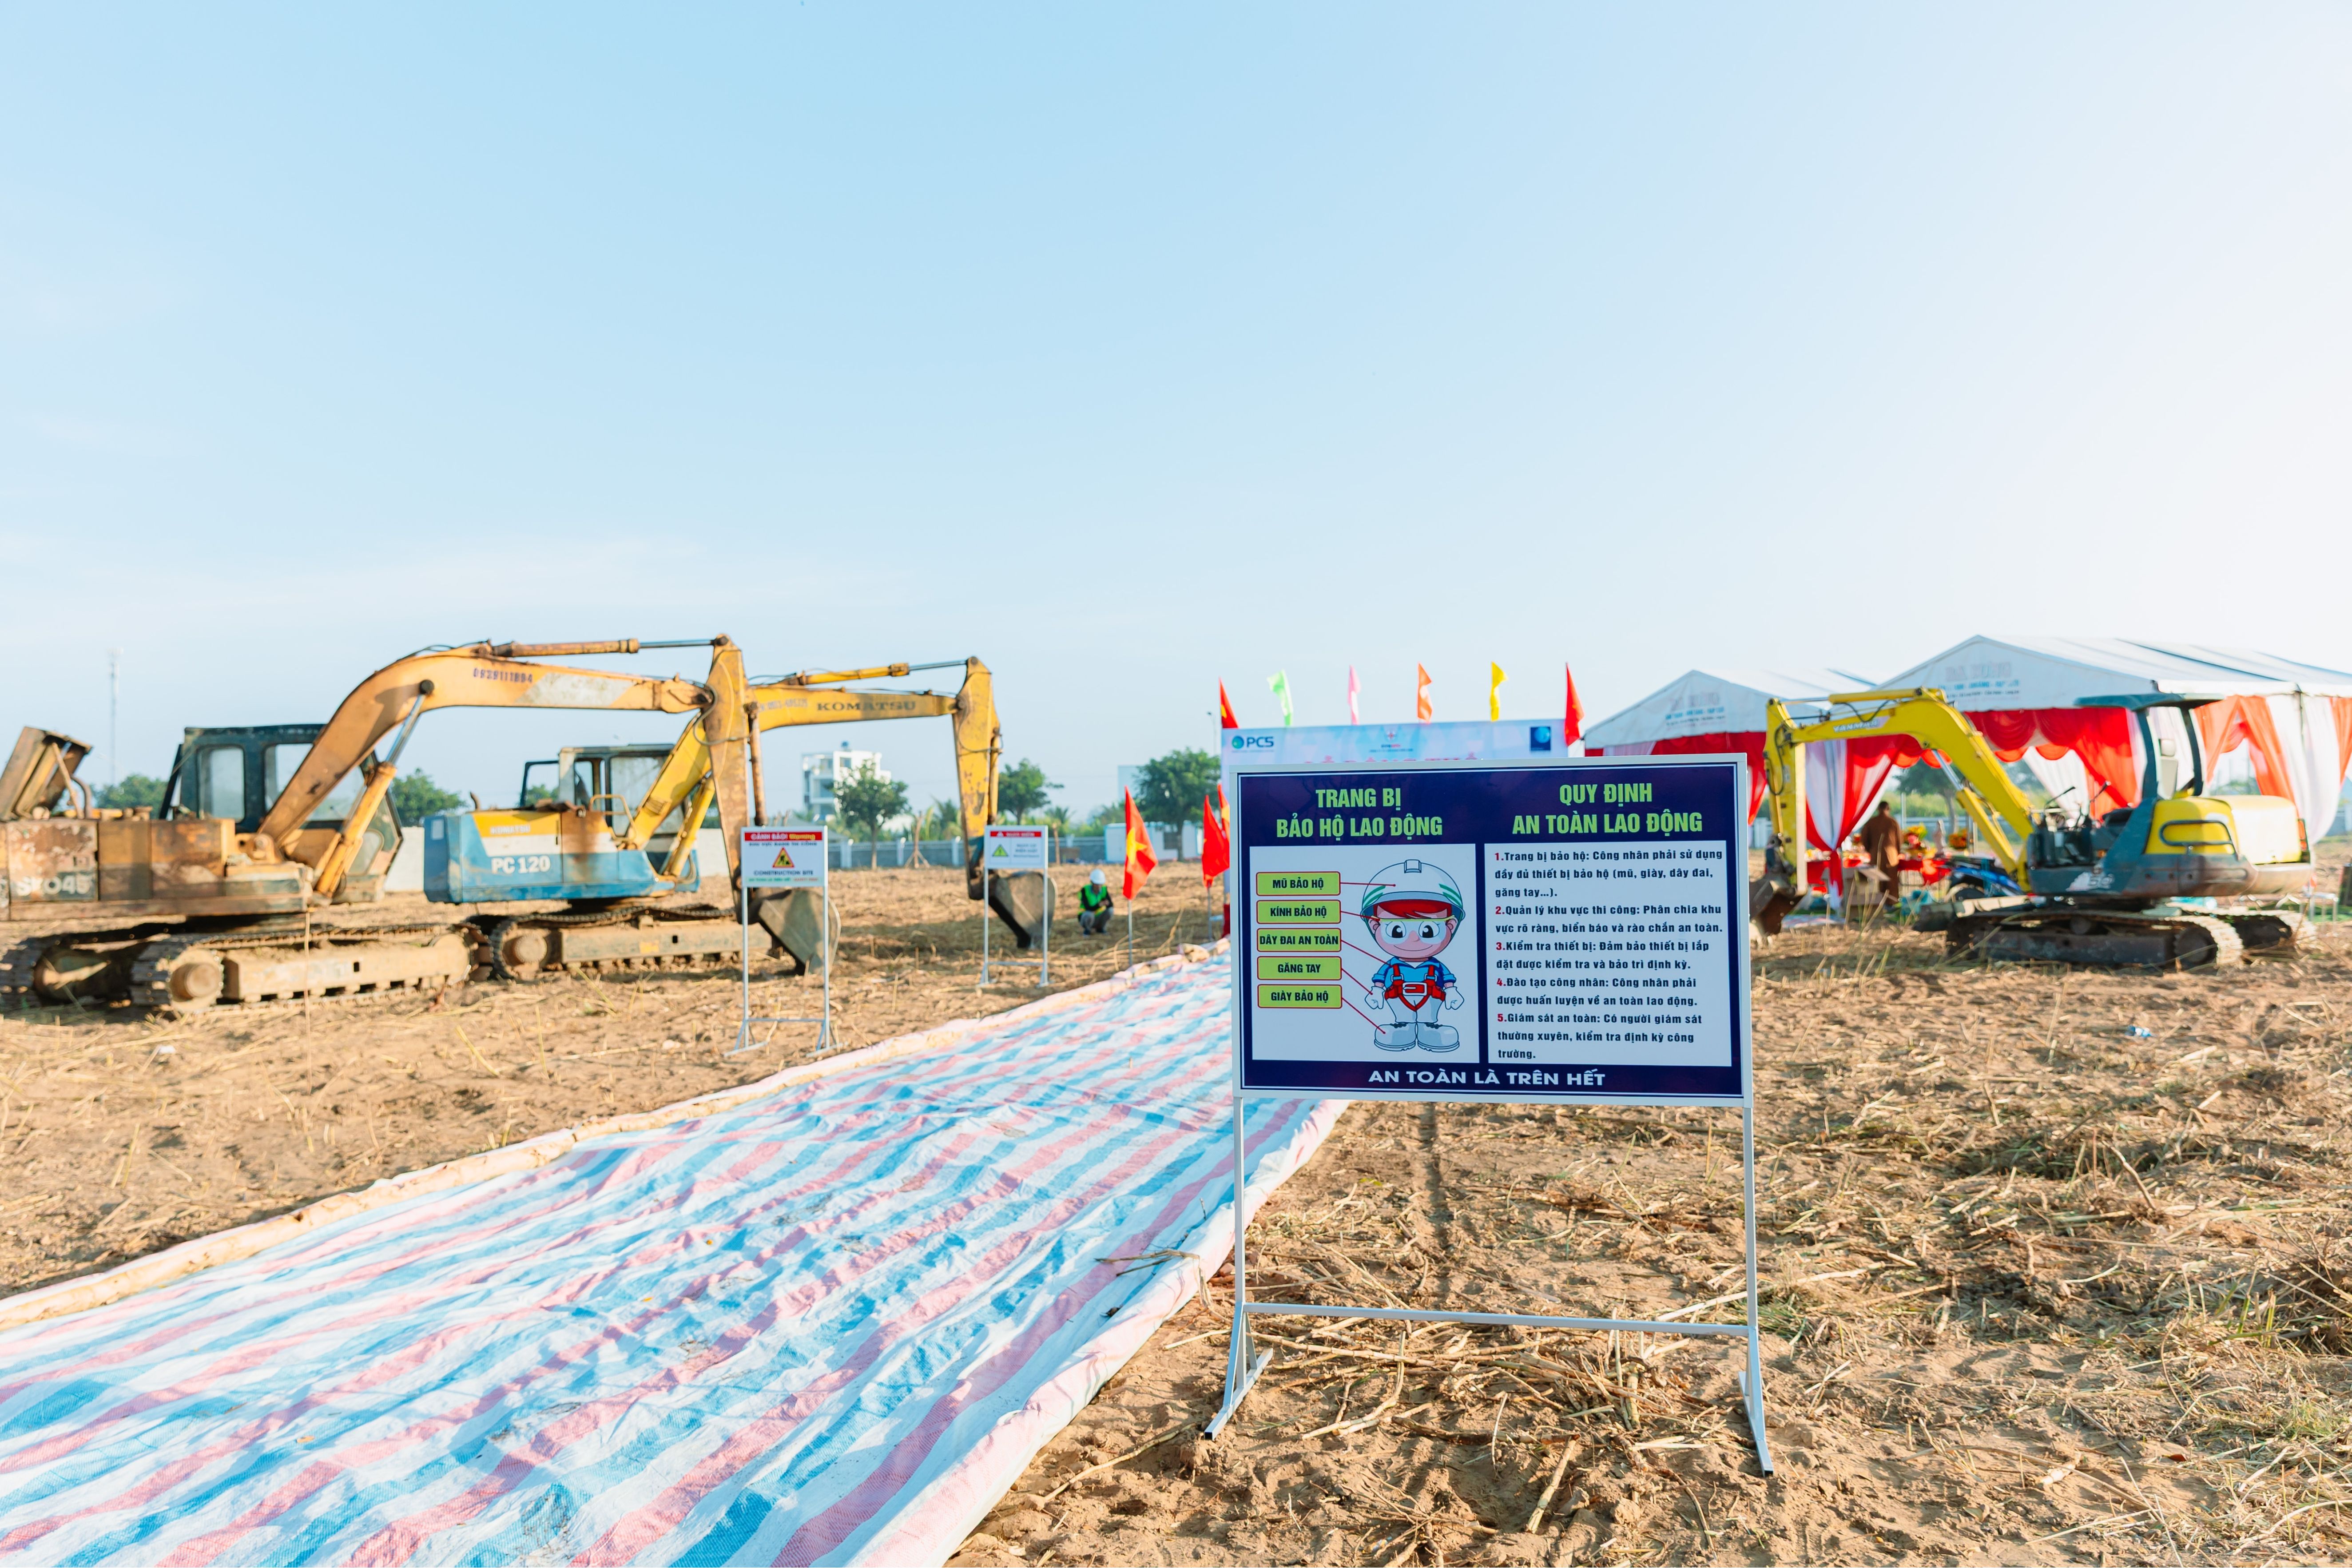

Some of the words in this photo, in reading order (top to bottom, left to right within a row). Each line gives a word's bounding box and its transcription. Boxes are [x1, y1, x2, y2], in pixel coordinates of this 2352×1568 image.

[817, 701, 916, 711] KOMATSU
[1247, 736, 1274, 747] PCS
[1315, 789, 1376, 807] TRANG
[1383, 789, 1400, 810] BỊ
[1560, 784, 1597, 805] QUY
[1603, 783, 1652, 806] ĐỊNH
[1276, 813, 1313, 838] BẢO
[1320, 814, 1344, 840] HỘ
[1350, 818, 1384, 837] LAO
[1390, 814, 1442, 840] ĐỘNG
[1512, 816, 1539, 834] AN
[1545, 810, 1597, 834] TOÀN
[1604, 814, 1640, 833] LAO
[1645, 809, 1702, 836] ĐỘNG
[491, 825, 531, 834] KOMATSU
[1537, 852, 1547, 862] bị
[1550, 850, 1569, 861] bảo
[1573, 851, 1589, 862] hộ:
[1593, 851, 1619, 861] Công
[1623, 850, 1649, 860] nhân
[1653, 849, 1676, 860] phải
[1680, 849, 1692, 859] sử
[1696, 850, 1722, 861] dụng
[492, 857, 515, 874] PC
[517, 855, 551, 874] 120
[1495, 869, 1513, 880] đầy
[1517, 869, 1529, 878] đủ
[1532, 868, 1557, 878] thiết
[1560, 869, 1570, 880] bị
[1573, 868, 1593, 878] bảo
[1596, 869, 1609, 880] hộ
[1613, 869, 1637, 879] (mũ,
[1641, 868, 1666, 879] giày,
[1669, 868, 1689, 878] dây
[1692, 868, 1713, 878] đai,
[1272, 878, 1287, 889] MŨ
[1290, 877, 1308, 888] BẢO
[1311, 877, 1324, 890] HỘ
[1495, 888, 1521, 898] găng
[1524, 888, 1557, 897] tay...).
[1270, 906, 1291, 917] KÍNH
[1294, 905, 1312, 917] BẢO
[1315, 906, 1327, 918] HỘ
[1535, 905, 1544, 916] lý
[1548, 906, 1567, 914] khu
[1570, 906, 1589, 916] vực
[1592, 905, 1606, 914] thi
[1610, 905, 1640, 915] công:
[1643, 905, 1670, 914] Phân
[1674, 905, 1697, 914] chia
[1701, 905, 1721, 913] khu
[1495, 925, 1514, 934] vực
[1518, 924, 1528, 933] rõ
[1531, 923, 1558, 933] ràng,
[1562, 922, 1585, 933] biển
[1589, 923, 1608, 933] báo
[1611, 923, 1624, 933] và
[1627, 923, 1645, 933] rào
[1649, 921, 1675, 933] chắn
[1694, 923, 1722, 932] toàn.
[1259, 934, 1277, 945] DÂY
[1280, 936, 1295, 945] ĐAI
[1298, 936, 1311, 945] AN
[1314, 934, 1339, 945] TOÀN
[1536, 942, 1551, 951] tra
[1554, 940, 1579, 951] thiết
[1582, 942, 1596, 953] bị:
[1599, 941, 1623, 951] Đảm
[1626, 941, 1646, 951] bảo
[1649, 940, 1675, 951] thiết
[1678, 941, 1688, 953] bị
[1692, 940, 1709, 952] lắp
[1278, 962, 1303, 973] GĂNG
[1306, 964, 1321, 973] TAY
[1496, 960, 1513, 970] đặt
[1516, 960, 1542, 970] được
[1545, 958, 1572, 969] kiểm
[1575, 960, 1590, 969] tra
[1593, 960, 1605, 969] và
[1609, 959, 1628, 969] bảo
[1631, 960, 1644, 969] trì
[1648, 960, 1671, 971] định
[1675, 960, 1691, 970] kỳ.
[1530, 978, 1546, 988] tạo
[1550, 977, 1576, 988] công
[1579, 978, 1609, 987] nhân:
[1612, 978, 1639, 988] Công
[1642, 978, 1669, 987] nhân
[1673, 977, 1696, 988] phải
[1271, 990, 1292, 1001] GIÀY
[1295, 989, 1313, 1001] BẢO
[1316, 990, 1328, 1003] HỘ
[1497, 996, 1522, 1006] được
[1526, 994, 1552, 1004] huấn
[1555, 996, 1584, 1007] luyện
[1587, 995, 1600, 1005] về
[1619, 996, 1643, 1005] toàn
[1647, 996, 1663, 1005] lao
[1667, 996, 1697, 1007] động.
[1538, 1013, 1554, 1022] sát
[1573, 1013, 1600, 1023] toàn:
[1604, 1014, 1617, 1023] Có
[1621, 1014, 1651, 1024] người
[1654, 1014, 1681, 1024] giám
[1685, 1014, 1702, 1024] sát
[1498, 1031, 1534, 1041] thường
[1537, 1032, 1573, 1042] xuyên,
[1576, 1030, 1602, 1041] kiểm
[1606, 1032, 1621, 1041] tra
[1625, 1032, 1648, 1043] định
[1652, 1032, 1664, 1043] kỳ
[1667, 1033, 1694, 1043] công
[1498, 1049, 1536, 1060] trường.
[1368, 1071, 1399, 1082] AN
[1406, 1068, 1466, 1083] TOÀN
[1474, 1069, 1500, 1084] LÀ
[1506, 1070, 1558, 1085] TRÊN
[1567, 1068, 1605, 1085] HẾT
